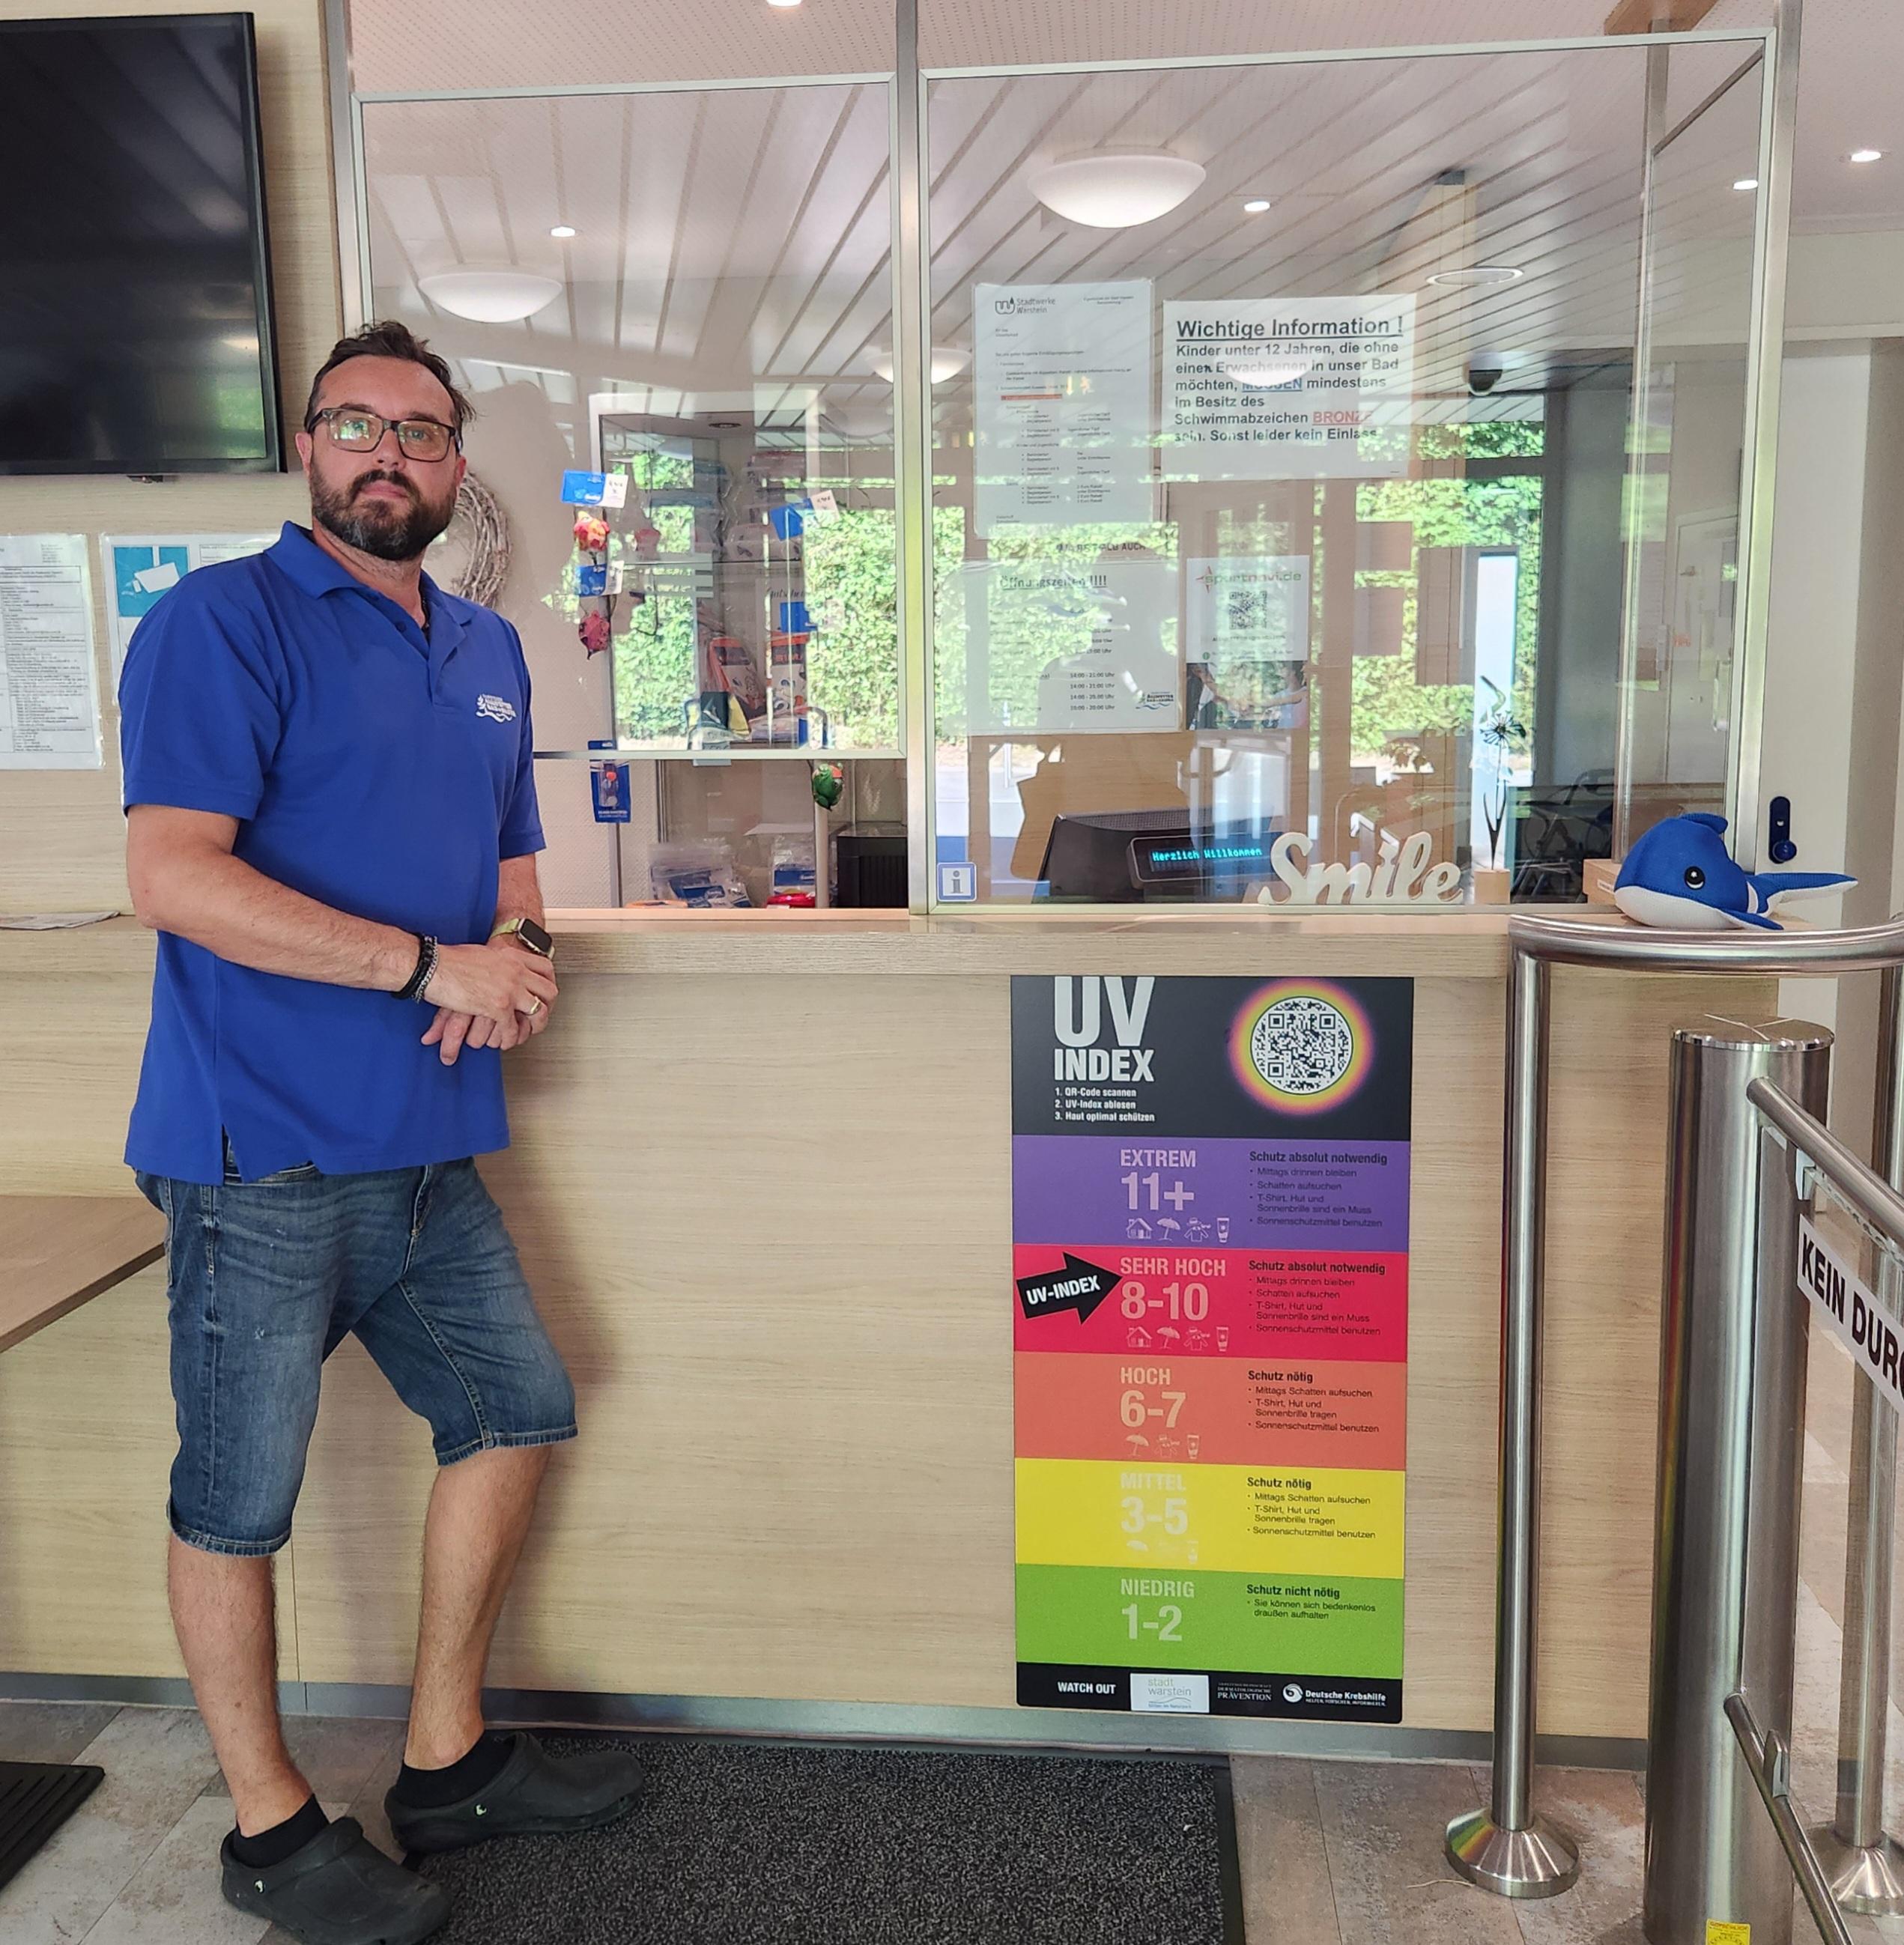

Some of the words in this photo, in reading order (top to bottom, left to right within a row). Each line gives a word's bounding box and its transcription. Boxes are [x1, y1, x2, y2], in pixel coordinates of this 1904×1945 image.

[1177, 321, 1265, 340] Wichtige
[1273, 318, 1389, 336] Information
[1398, 316, 1403, 333] !
[1176, 345, 1220, 356] Kinder
[1225, 344, 1260, 356] unter
[1265, 344, 1280, 355] 12
[1284, 342, 1335, 356] Jahren,
[1339, 342, 1359, 354] die
[1364, 341, 1398, 353] ohne
[1216, 360, 1307, 374] Erwachsenen
[1312, 359, 1324, 371] in
[1328, 362, 1367, 371] unser
[1372, 358, 1398, 370] Bad
[1175, 379, 1237, 392] möchten,
[1307, 377, 1386, 389] mindestens
[1175, 397, 1190, 408] im
[1196, 396, 1237, 407] Besitz
[1240, 395, 1264, 407] des
[1174, 412, 1309, 425] Schwimmabzeichen
[1174, 430, 1206, 442] sein.
[1210, 429, 1249, 441] Sonst
[1253, 428, 1291, 440] leider
[1295, 429, 1323, 440] kein
[1327, 428, 1377, 440] Einlass
[1152, 849, 1199, 863] Herzlich
[1258, 831, 1465, 905] Smile
[1054, 976, 1155, 1048] UV
[1054, 1049, 1154, 1082] INDEX
[1055, 1087, 1063, 1096] 1.
[1065, 1087, 1101, 1097] QR-Code
[1103, 1089, 1137, 1097] scannen
[1055, 1099, 1063, 1108] 2.
[1065, 1099, 1102, 1109] UV-Index
[1104, 1100, 1136, 1109] ablesen
[1055, 1111, 1063, 1120] 3.
[1065, 1111, 1085, 1120] Haut
[1086, 1112, 1117, 1122] optimal
[1119, 1112, 1155, 1121] schützen
[1121, 1148, 1196, 1168] EXTREM
[1249, 1151, 1286, 1163] Schutz
[1288, 1152, 1328, 1164] absolut
[1331, 1153, 1388, 1166] notwendig
[1257, 1168, 1289, 1178] Mittags
[1291, 1168, 1323, 1177] drinnen
[1324, 1168, 1357, 1177] bleiben
[1121, 1171, 1195, 1211] 11+
[1257, 1180, 1295, 1190] Schatten
[1297, 1181, 1342, 1191] aufsuchen
[1289, 1194, 1306, 1203] Hut
[1308, 1195, 1324, 1203] und
[1257, 1204, 1310, 1213] Sonnenbrille
[1313, 1204, 1330, 1213] sind
[1332, 1205, 1345, 1214] ein
[1347, 1205, 1372, 1214] Muss
[1257, 1216, 1341, 1227] Sonnenschutzmittel
[1343, 1218, 1383, 1228] benutzen
[1121, 1257, 1169, 1275] SEHR
[1174, 1258, 1226, 1276] HOCH
[1249, 1260, 1285, 1272] Schutz
[1288, 1260, 1328, 1272] absolut
[1330, 1261, 1386, 1275] notwendig
[1256, 1276, 1288, 1287] Mittags
[1289, 1277, 1321, 1286] drinnen
[1323, 1277, 1355, 1287] bleiben
[1801, 1232, 1846, 1325] KEIN
[1026, 1275, 1101, 1305] UV-INDEX
[1256, 1289, 1294, 1298] Schatten
[1296, 1290, 1340, 1299] aufsuchen
[1121, 1280, 1209, 1320] 8-10
[1256, 1301, 1287, 1311] T-Shirt,
[1289, 1302, 1305, 1311] Hut
[1306, 1302, 1323, 1311] und
[1256, 1311, 1309, 1321] Sonnenbrille
[1311, 1312, 1329, 1321] sind
[1330, 1313, 1344, 1322] ein
[1347, 1314, 1370, 1323] Muss
[1256, 1324, 1338, 1335] Sonnenschutzmittel
[1341, 1325, 1380, 1335] benutzen
[1121, 1368, 1171, 1386] HOCH
[1248, 1371, 1285, 1382] Schutz
[1286, 1371, 1313, 1383] nötig
[1255, 1386, 1287, 1397] Mittags
[1289, 1386, 1327, 1397] Schatten
[1328, 1388, 1373, 1398] aufsuchen
[1121, 1391, 1186, 1428] 6-7
[1255, 1398, 1286, 1409] T-Shirt,
[1288, 1399, 1304, 1408] Hut
[1306, 1400, 1322, 1408] und
[1255, 1409, 1308, 1418] Sonnenbrille
[1309, 1410, 1337, 1420] tragen
[1255, 1421, 1338, 1431] Sonnenschutzmittel
[1339, 1422, 1380, 1433] benutzen
[1121, 1473, 1186, 1492] MITTEL
[1247, 1477, 1283, 1489] Schutz
[1285, 1478, 1312, 1490] nötig
[1255, 1493, 1285, 1504] Mittags
[1288, 1493, 1325, 1503] Schatten
[1327, 1494, 1371, 1505] aufsuchen
[1121, 1496, 1188, 1535] 3-5
[1255, 1505, 1285, 1515] T-Shirt,
[1287, 1505, 1302, 1514] Hut
[1304, 1506, 1321, 1514] und
[1255, 1515, 1306, 1525] Sonnenbrille
[1308, 1516, 1335, 1526] tragen
[1253, 1526, 1335, 1538] Sonnenschutzmittel
[1337, 1529, 1376, 1539] benutzen
[1121, 1578, 1195, 1598] NIEDRIG
[1246, 1584, 1282, 1596] Schutz
[1284, 1585, 1311, 1597] nicht
[1313, 1586, 1340, 1599] nötig
[1255, 1599, 1268, 1608] Sie
[1270, 1600, 1302, 1609] können
[1303, 1600, 1321, 1610] sich
[1322, 1601, 1376, 1612] bedenkenlos
[1255, 1609, 1288, 1618] draußen
[1291, 1610, 1329, 1620] aufhalten
[1121, 1603, 1183, 1642] 1-2
[1057, 1681, 1094, 1693] WATCH
[1095, 1684, 1116, 1695] OUT
[1148, 1676, 1174, 1687] stadt
[1147, 1687, 1192, 1696] warstein
[1217, 1692, 1272, 1701] PRÄVENTION
[1305, 1690, 1343, 1699] Deutsche
[1344, 1692, 1386, 1702] Krebshilfe
